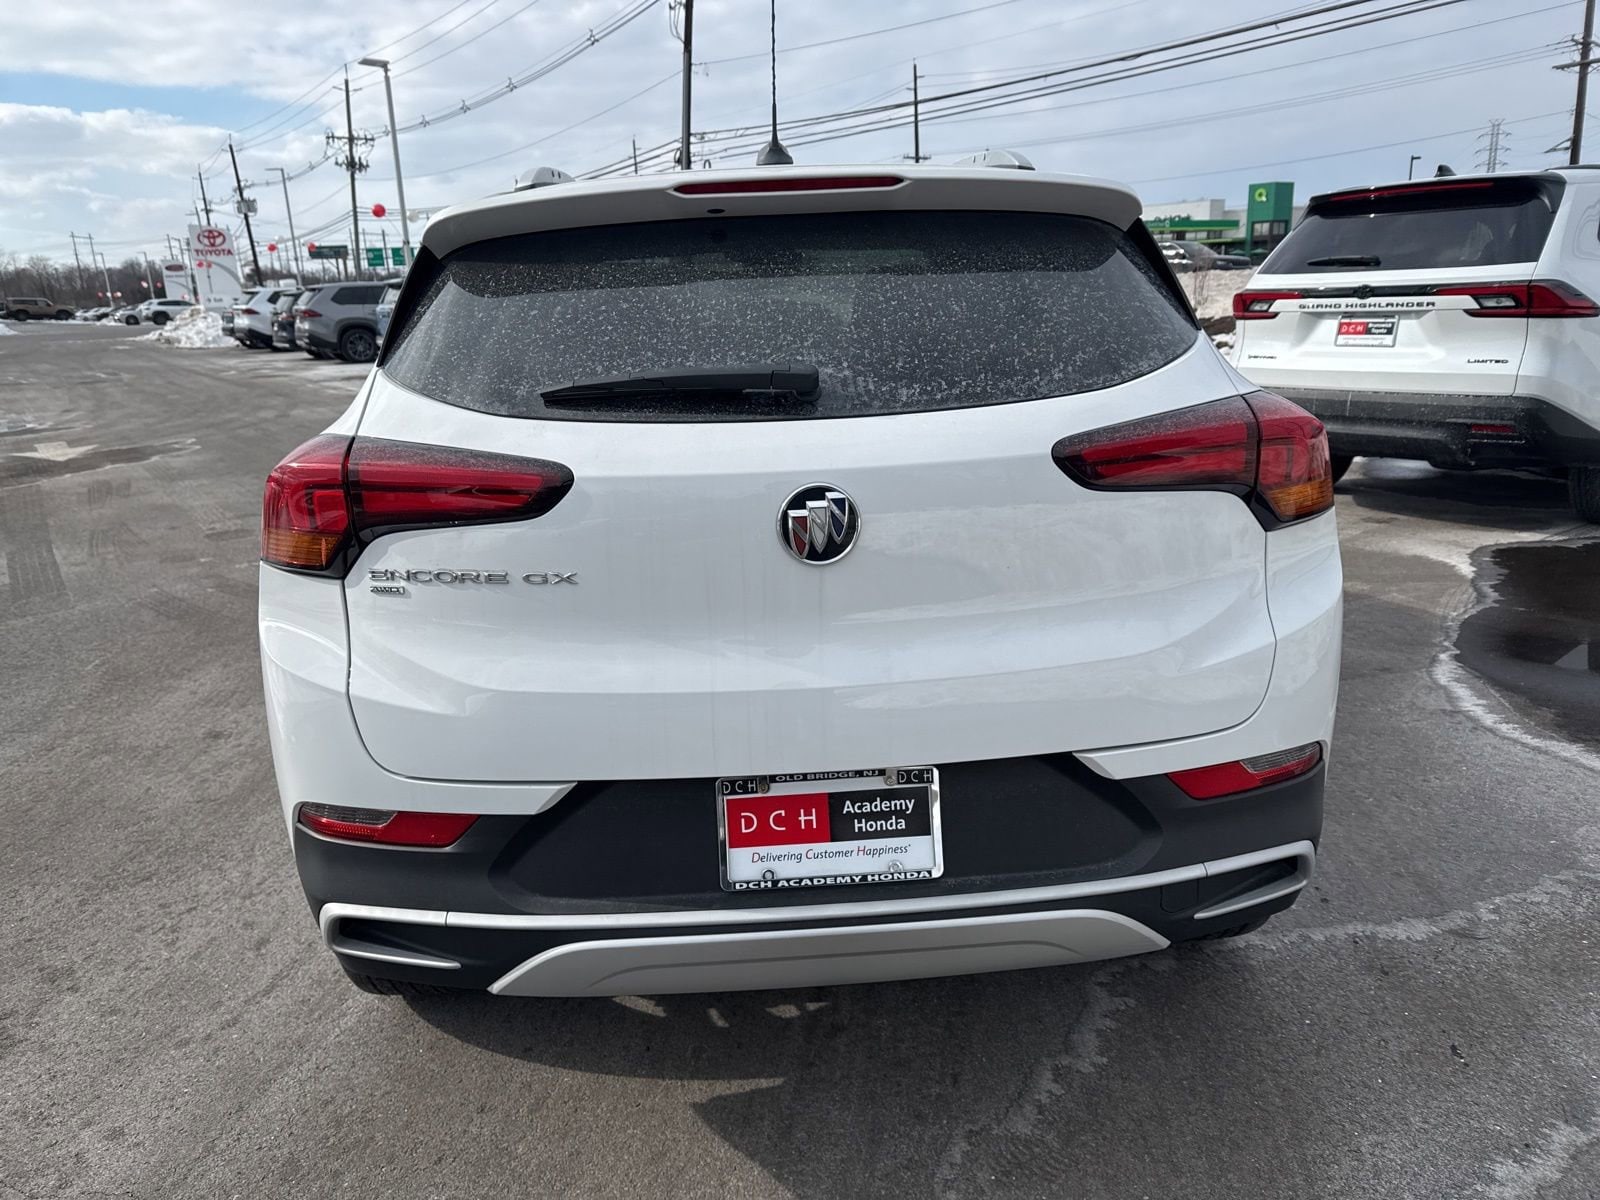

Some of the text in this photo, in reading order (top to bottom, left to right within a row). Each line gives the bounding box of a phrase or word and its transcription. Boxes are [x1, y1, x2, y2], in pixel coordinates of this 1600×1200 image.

[194, 248, 234, 257] TOYOTA
[1345, 301, 1436, 309] HIGHLANDER
[368, 568, 579, 585] ENCORE GX
[776, 769, 879, 781] OLD BRIDGE, NJ
[842, 797, 915, 815] Academy
[741, 808, 817, 834] DCH
[854, 816, 906, 833] Honda
[751, 851, 803, 864] Delivering
[805, 848, 855, 860] Customer
[735, 870, 932, 890] DCH ACADEMY HONDA
